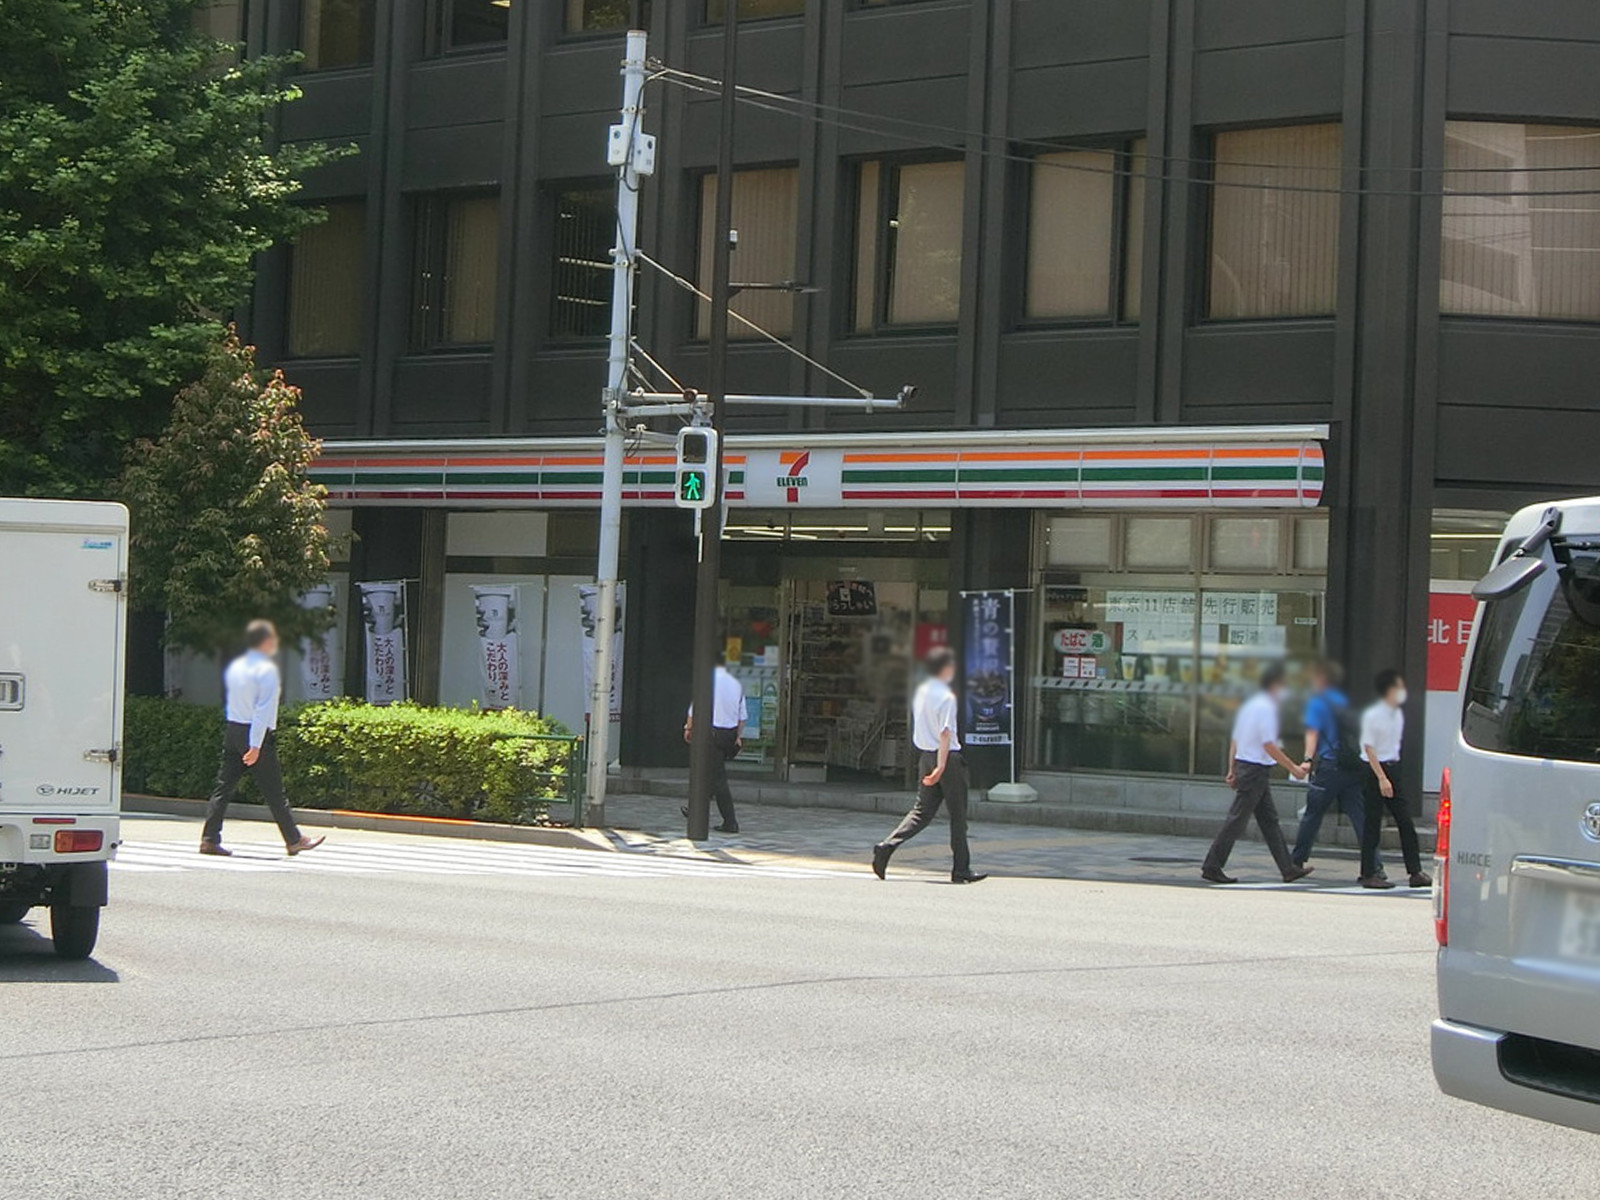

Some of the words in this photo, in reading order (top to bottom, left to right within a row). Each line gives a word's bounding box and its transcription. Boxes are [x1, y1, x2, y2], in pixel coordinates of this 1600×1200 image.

[1061, 632, 1087, 647] たばこ
[497, 643, 510, 702] 大人の深みと
[56, 787, 101, 796] HIJET
[1457, 850, 1492, 868] HIACE
